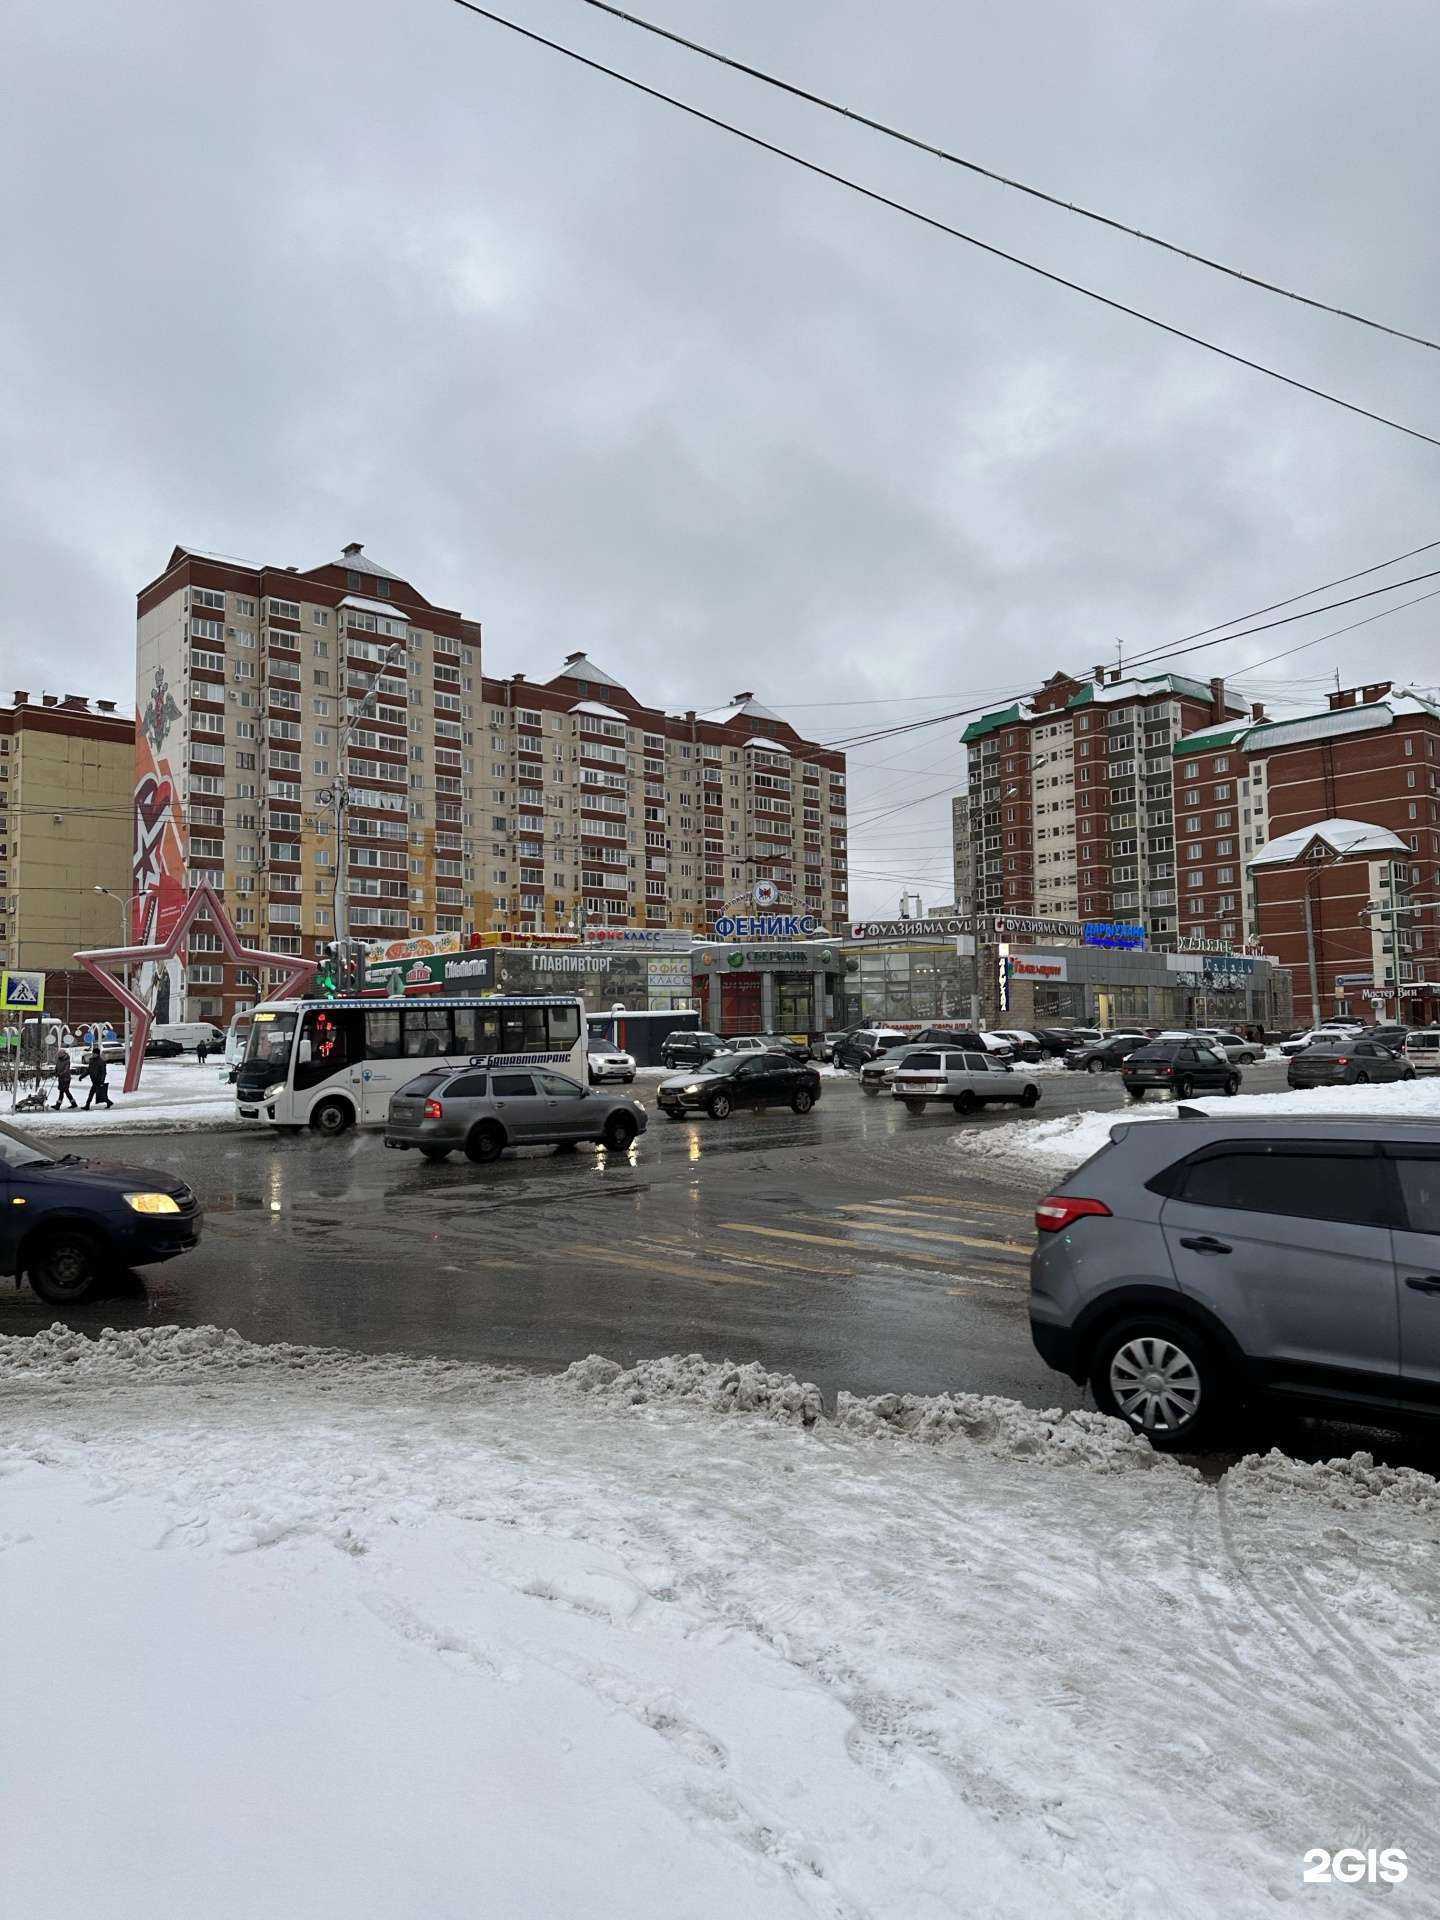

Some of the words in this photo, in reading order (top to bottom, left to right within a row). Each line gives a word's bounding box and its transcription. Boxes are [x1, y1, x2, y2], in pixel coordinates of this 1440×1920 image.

[715, 915, 818, 936] ФЕНИКС
[867, 921, 945, 936] ФУДЗИЯМА
[1006, 923, 1057, 935] ФУДЗИЯМА
[1058, 924, 1084, 936] СУШИ
[746, 950, 808, 961] СБЕРБАНК
[532, 954, 613, 972] ГЛАВПИВТОРГ
[648, 964, 688, 973] ОФИС
[649, 975, 690, 985] КЛАСС
